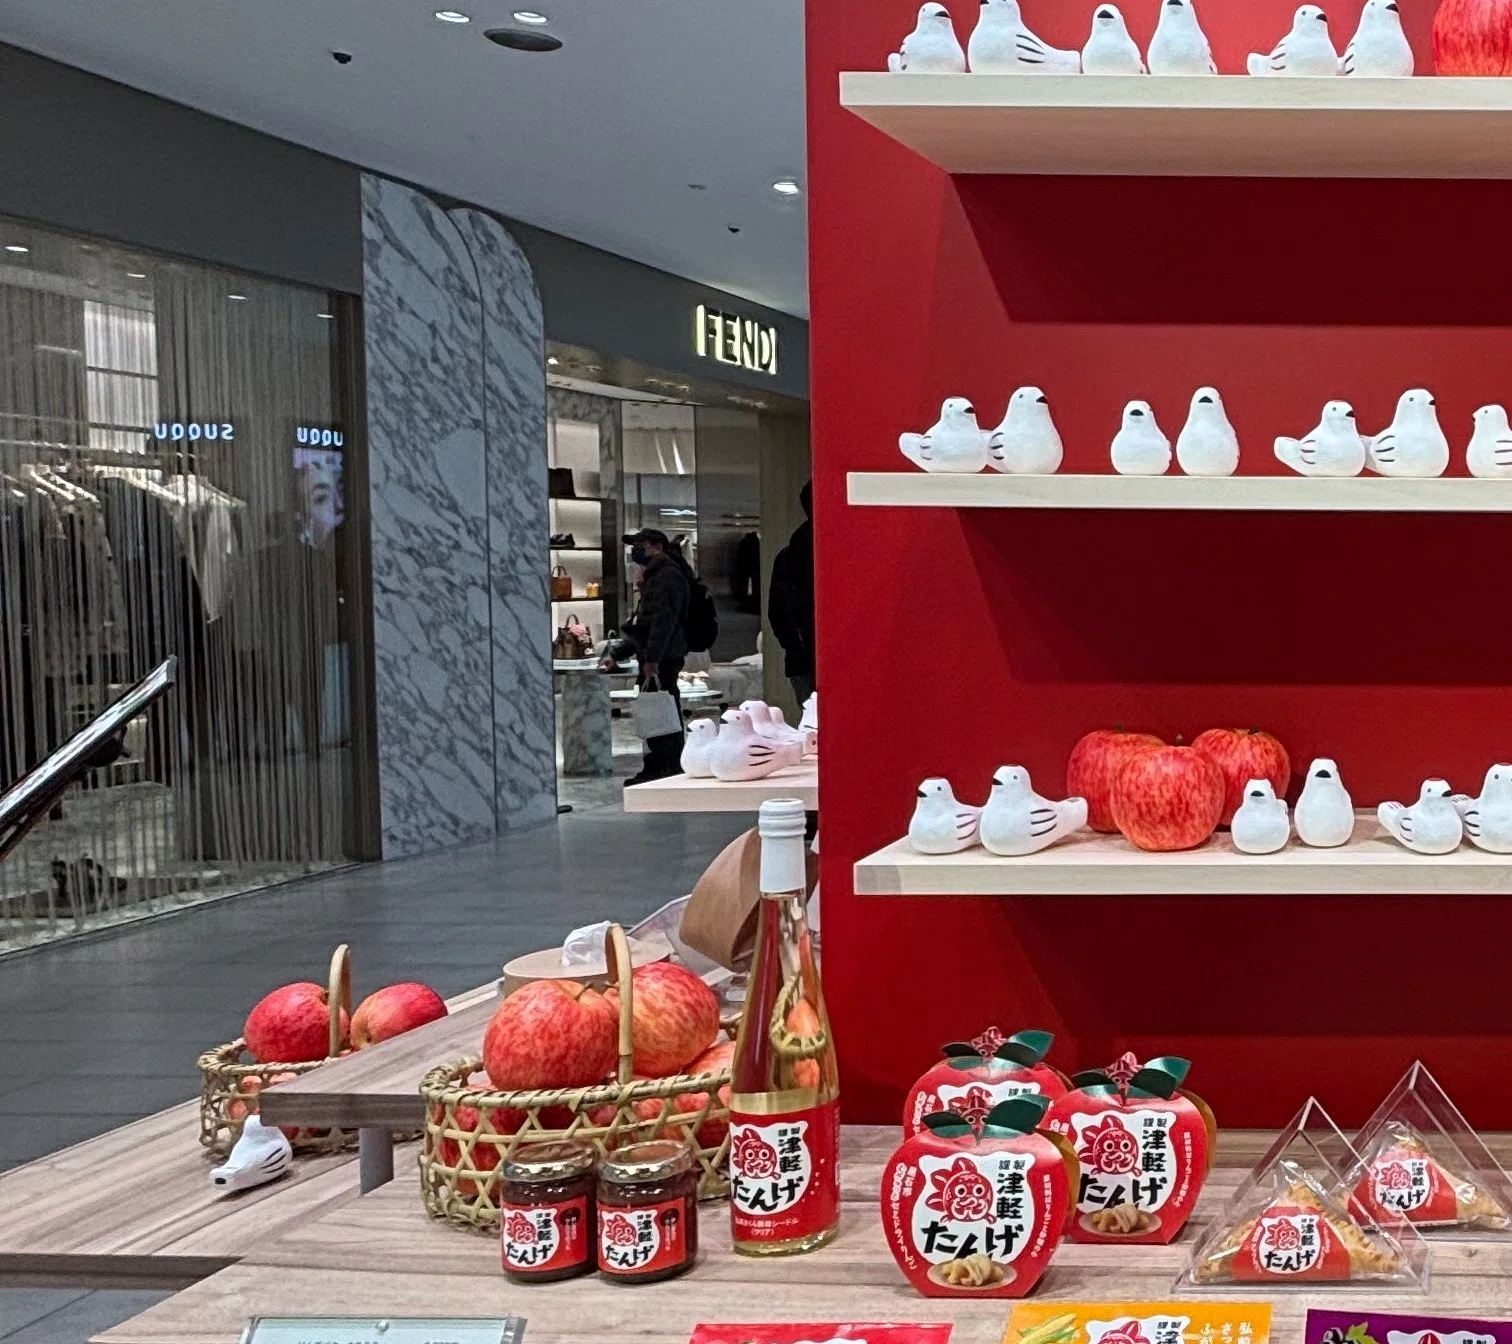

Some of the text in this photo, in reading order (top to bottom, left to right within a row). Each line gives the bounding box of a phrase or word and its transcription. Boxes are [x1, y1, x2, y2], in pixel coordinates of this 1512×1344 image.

[696, 304, 778, 375] FENDI
[1141, 1129, 1167, 1173] 津軽
[732, 1175, 804, 1212] たんげ
[996, 1172, 1025, 1220] 津軽
[1078, 1173, 1168, 1210] たんげ
[1380, 1188, 1427, 1210] たんげ
[505, 1242, 554, 1266] たんげ
[605, 1244, 654, 1268] たんげ
[920, 1220, 1024, 1261] たんげ
[1263, 1248, 1316, 1272] たんげ
